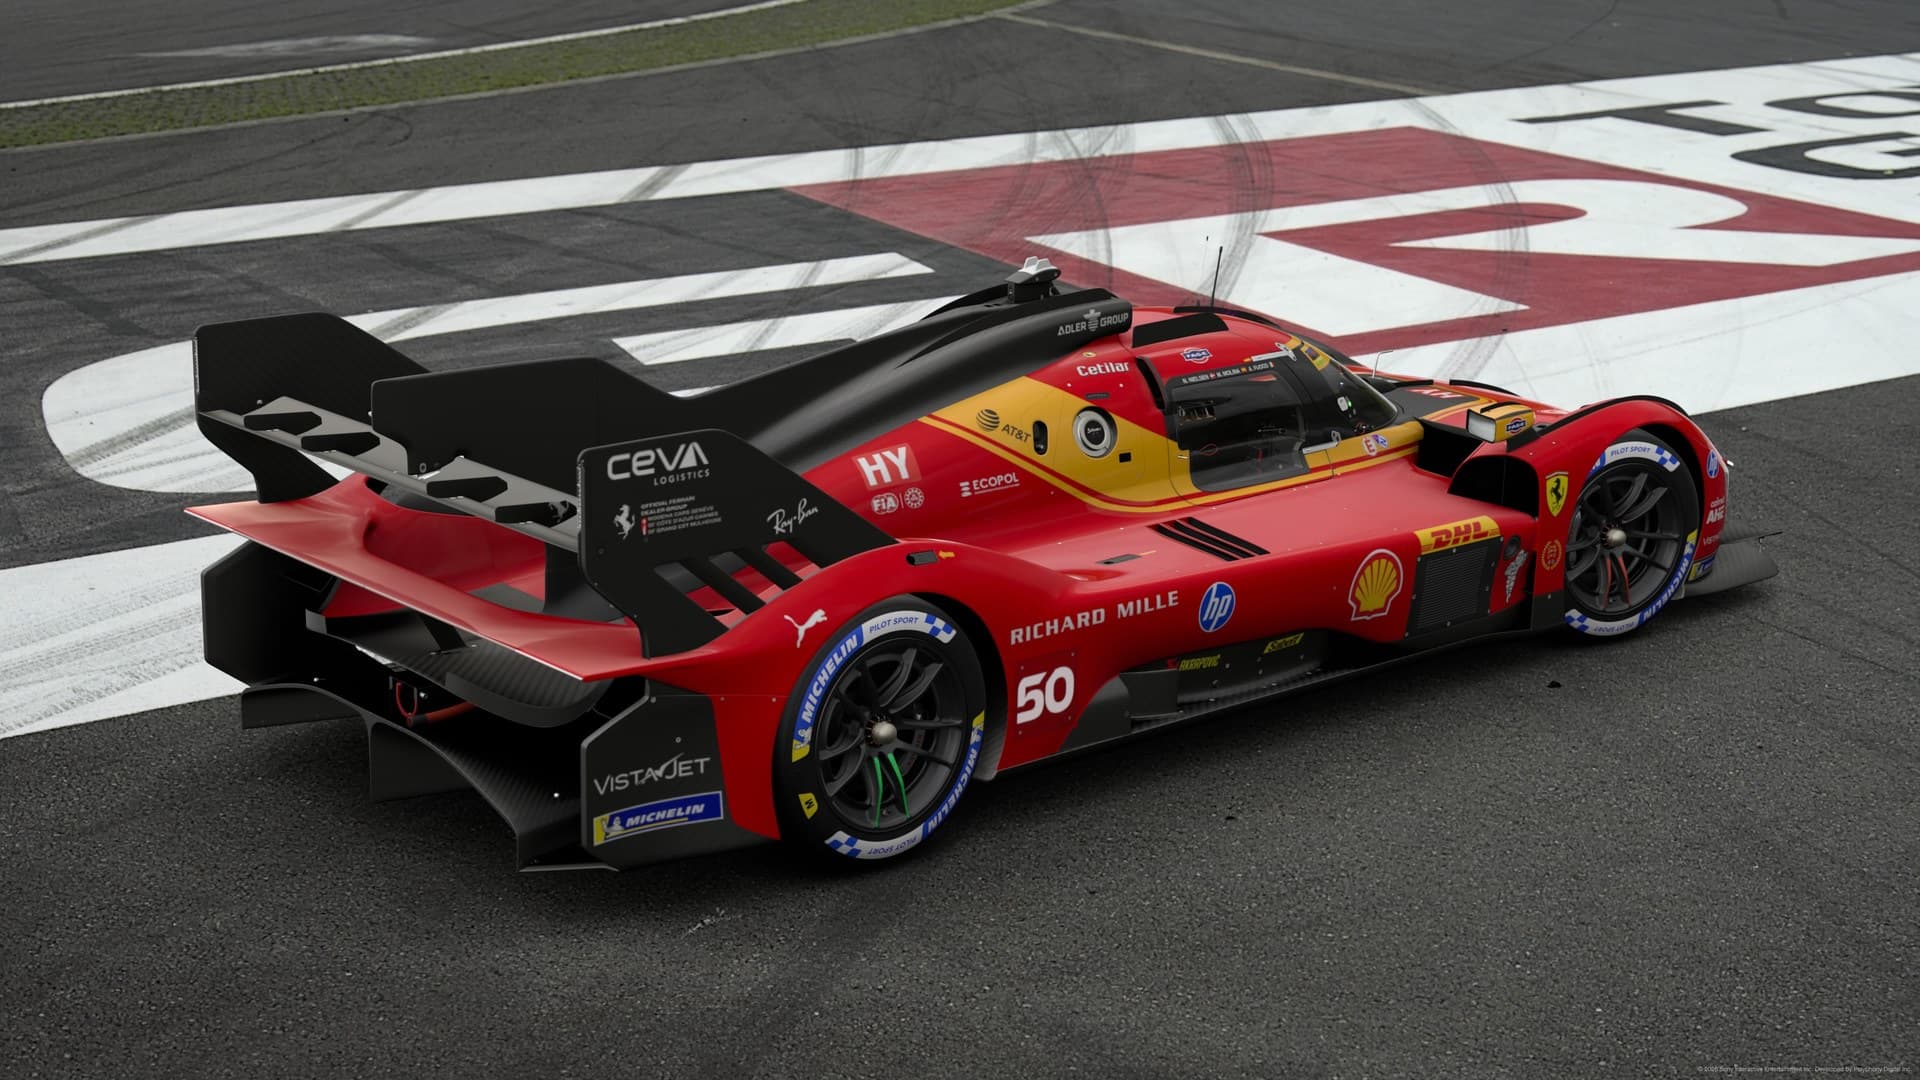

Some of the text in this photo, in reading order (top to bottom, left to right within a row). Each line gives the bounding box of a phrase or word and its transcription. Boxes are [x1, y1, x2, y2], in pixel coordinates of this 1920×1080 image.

[1057, 312, 1129, 336] ADLER GROUP
[1076, 362, 1129, 377] Cetilar
[1001, 424, 1031, 443] AT&T
[1610, 446, 1651, 457] PILOT SPORT
[653, 468, 710, 486] LOGISTICS
[857, 446, 910, 487] HY
[972, 472, 1020, 490] ECOPOL
[872, 496, 897, 512] FIA
[1431, 521, 1489, 549] DHL
[1643, 557, 1690, 620] MICHELIN
[1009, 590, 1180, 646] RICHARD MILLE
[1202, 583, 1233, 632] hp
[869, 616, 920, 633] PILOT SPORT
[801, 634, 858, 724] MICHELIN
[1016, 666, 1075, 725] 50
[593, 752, 711, 796] VISTAJET
[927, 748, 978, 833] MICHELIN
[625, 803, 706, 828] MICHELIN
